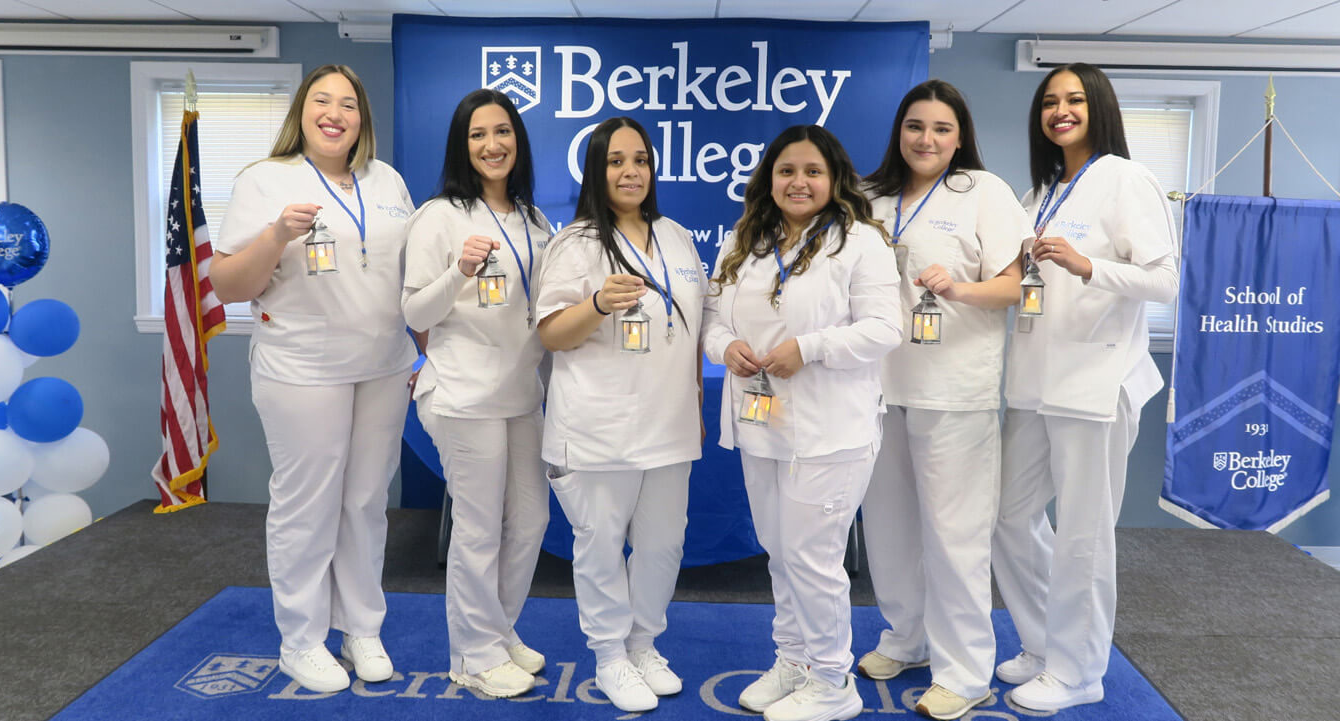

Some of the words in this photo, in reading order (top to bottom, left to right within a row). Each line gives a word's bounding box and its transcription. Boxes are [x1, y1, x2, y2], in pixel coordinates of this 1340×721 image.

[554, 41, 852, 127] Berkeley
[567, 120, 766, 203] Clleg
[1224, 286, 1281, 305] School
[1287, 286, 1307, 305] of
[1200, 314, 1260, 333] Health
[1265, 314, 1324, 334] Studies
[1245, 423, 1269, 436] 1931
[1227, 449, 1292, 473] Berkeley
[1231, 470, 1287, 492] College
[267, 658, 644, 720] Berle
